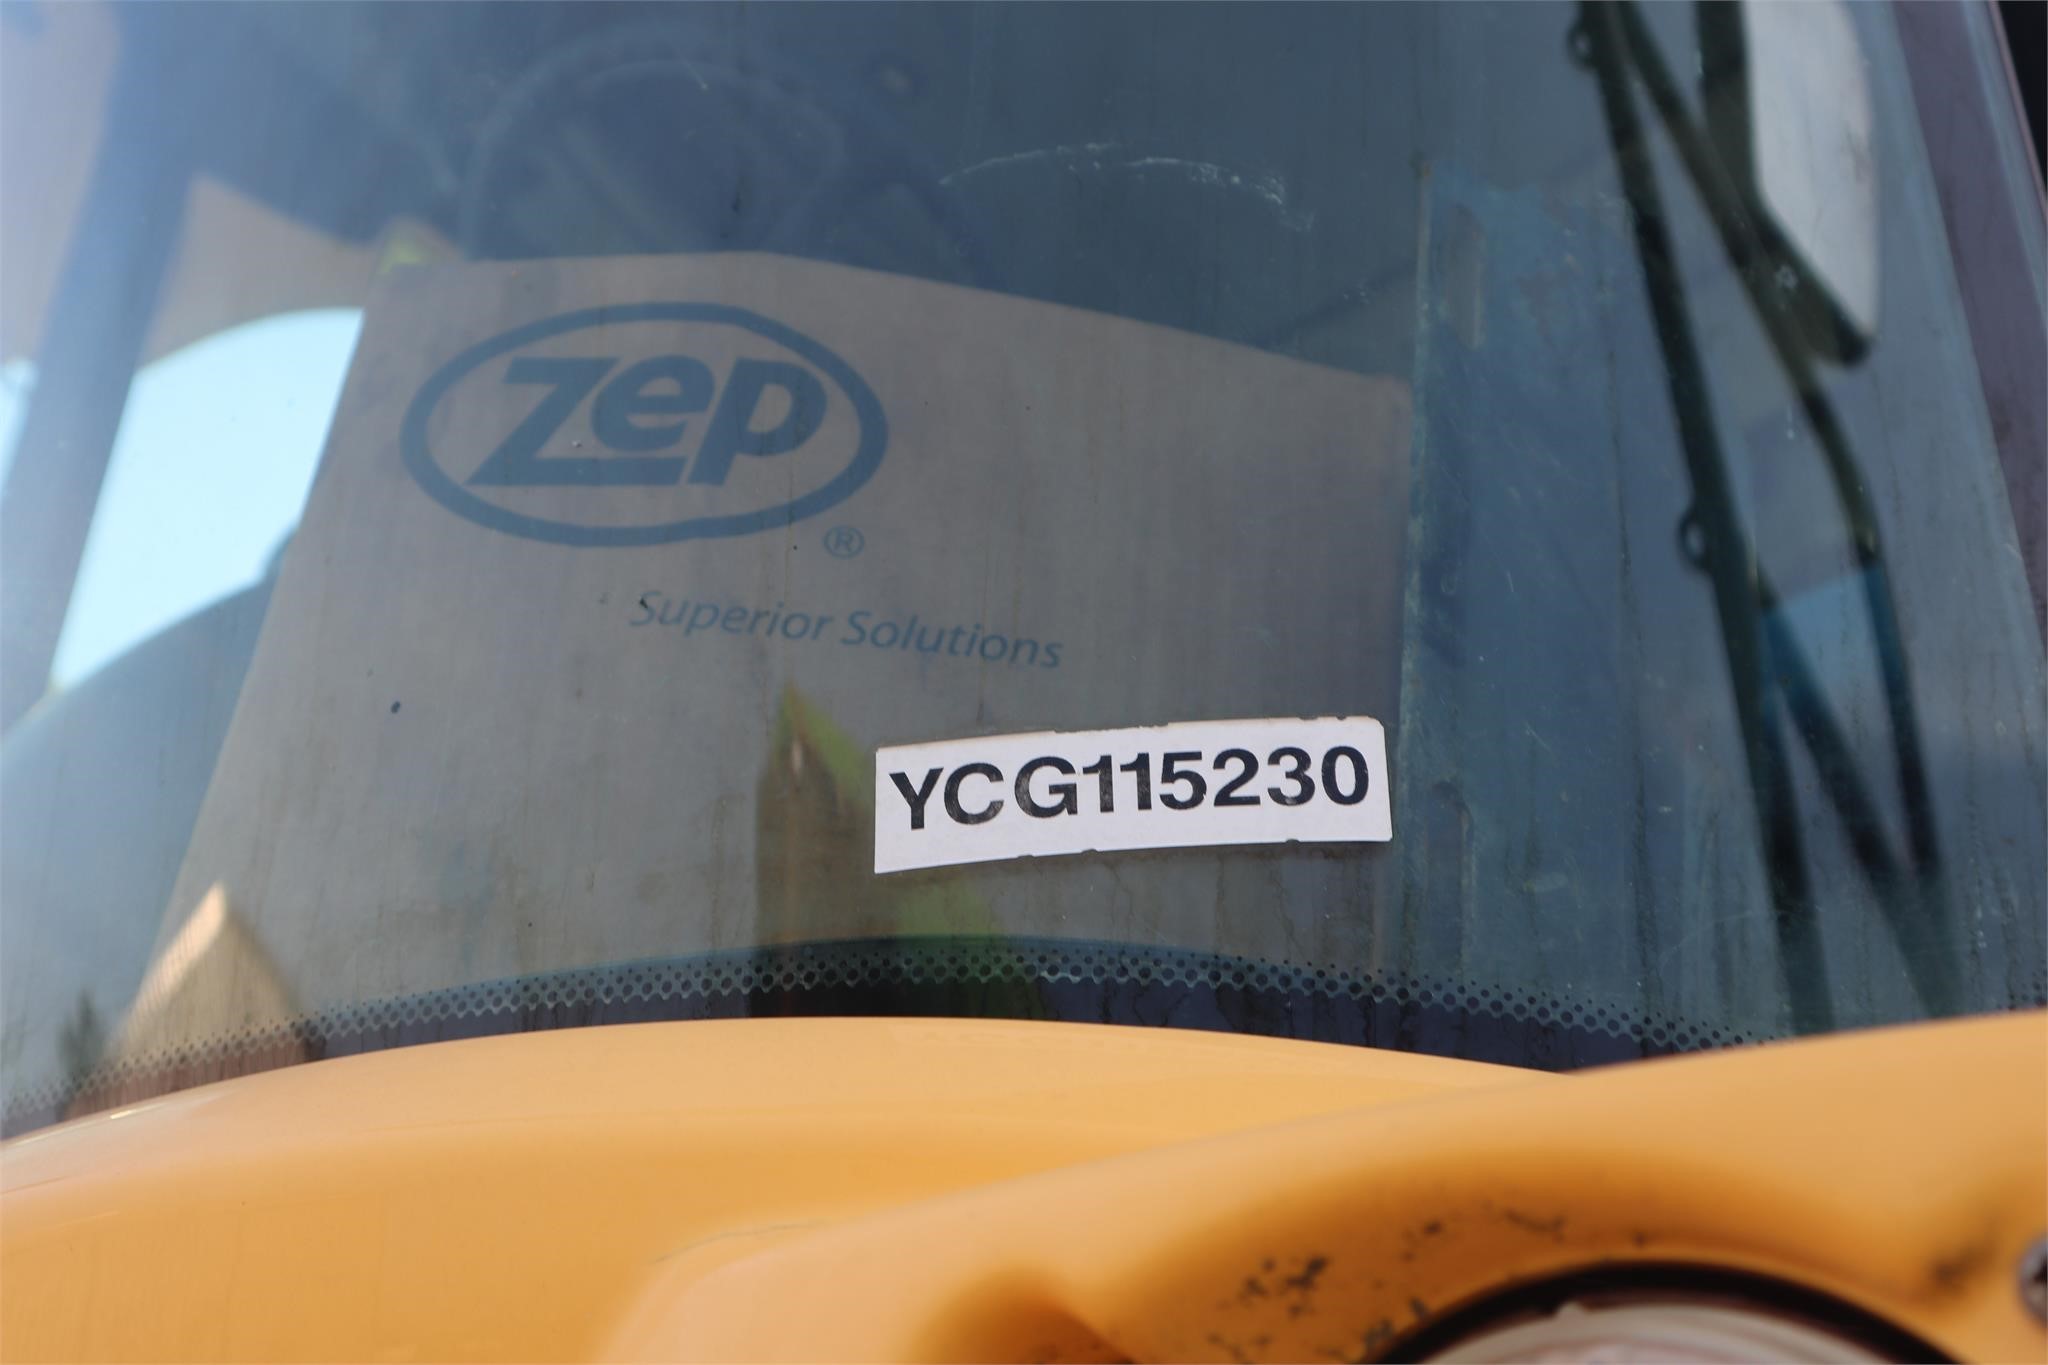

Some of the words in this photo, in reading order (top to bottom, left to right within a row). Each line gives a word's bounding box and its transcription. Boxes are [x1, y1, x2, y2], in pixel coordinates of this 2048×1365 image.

[629, 590, 834, 641] Superior
[840, 610, 1064, 668] Solutions
[889, 745, 1370, 830] YCG115230
